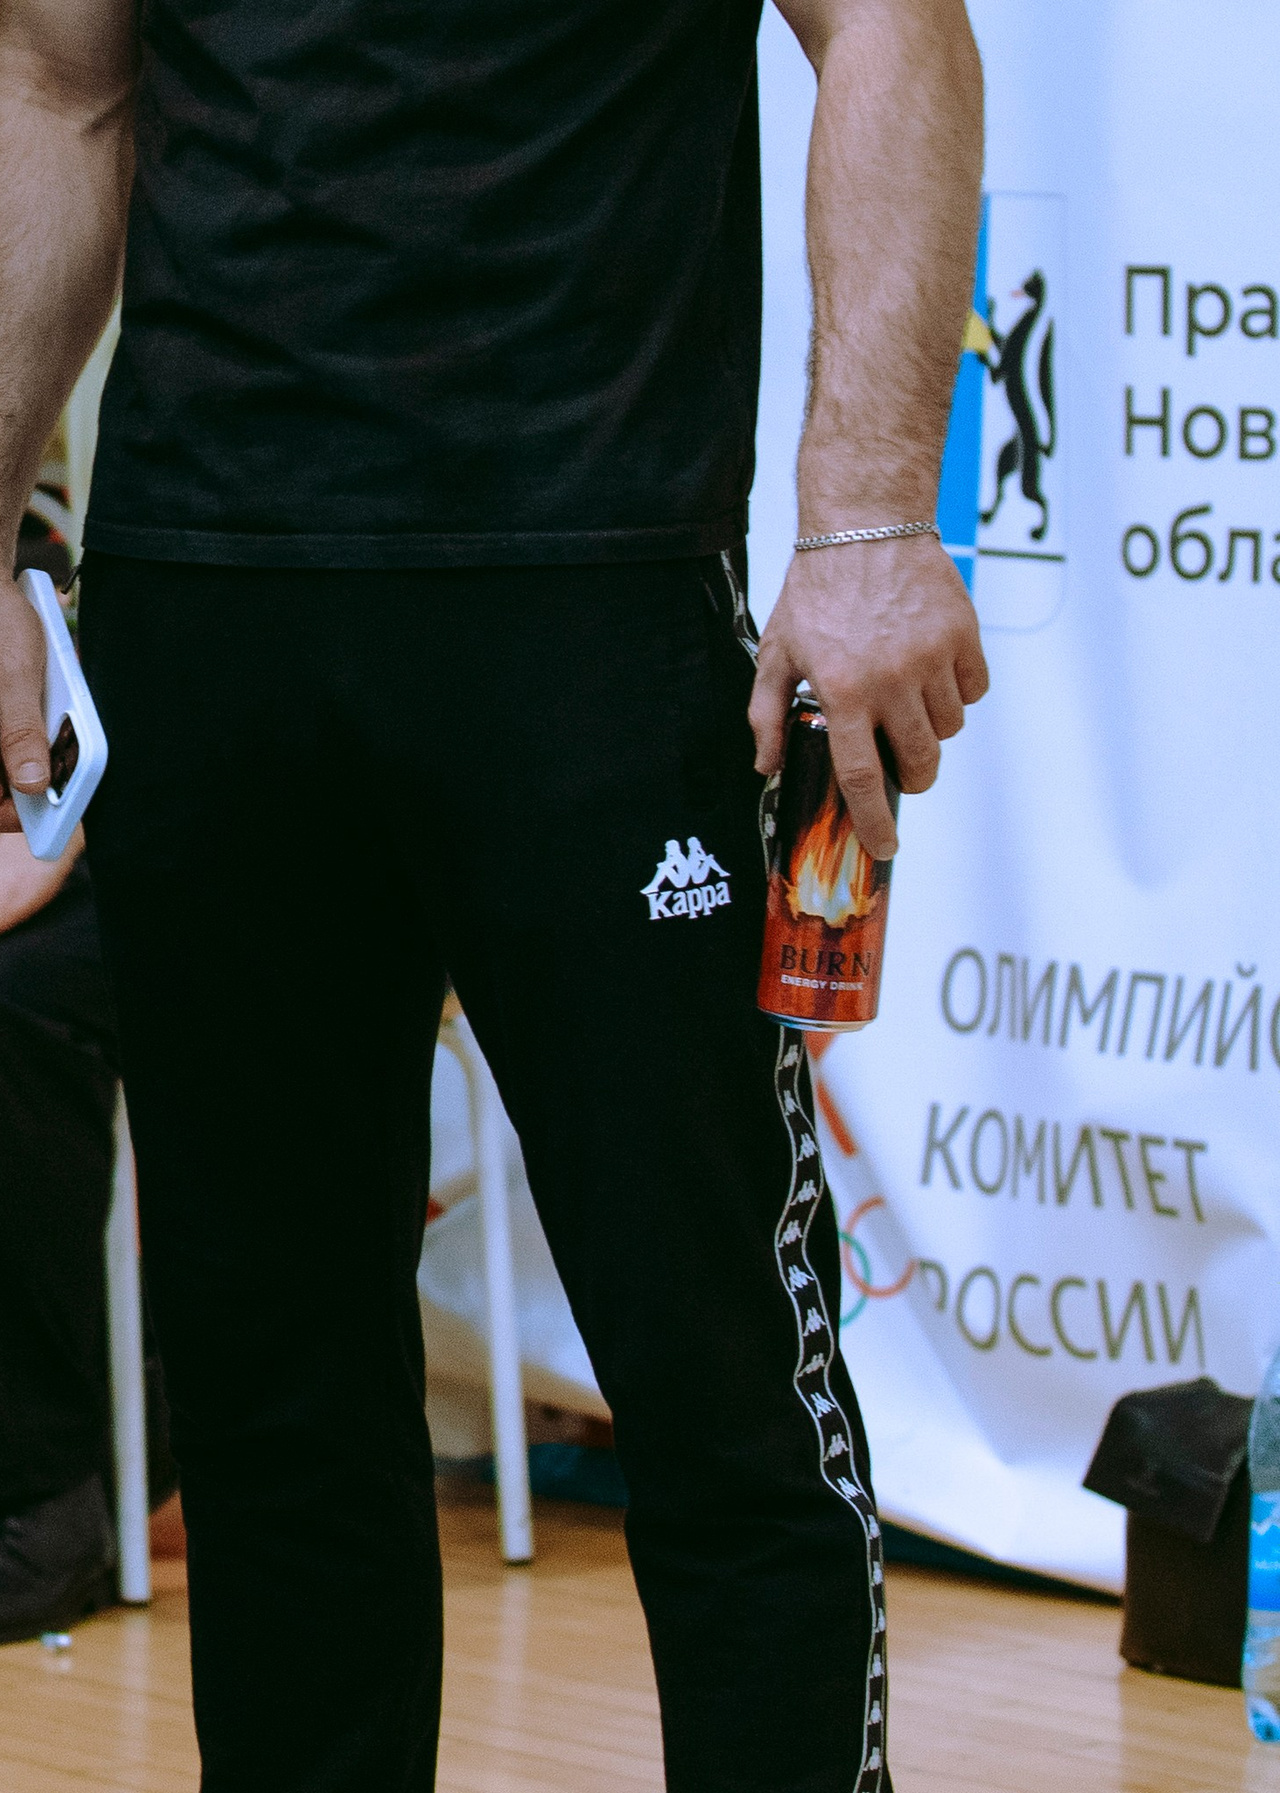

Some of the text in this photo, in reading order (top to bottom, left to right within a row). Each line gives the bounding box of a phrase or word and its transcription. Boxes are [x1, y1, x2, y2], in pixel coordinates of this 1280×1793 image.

[1125, 265, 1279, 357] Пра
[1124, 383, 1277, 462] Нов
[646, 881, 732, 920] Kappa
[780, 944, 872, 976] BURN
[781, 974, 864, 991] ENERGY DRINK
[920, 1103, 1207, 1223] КОМИТЕТ
